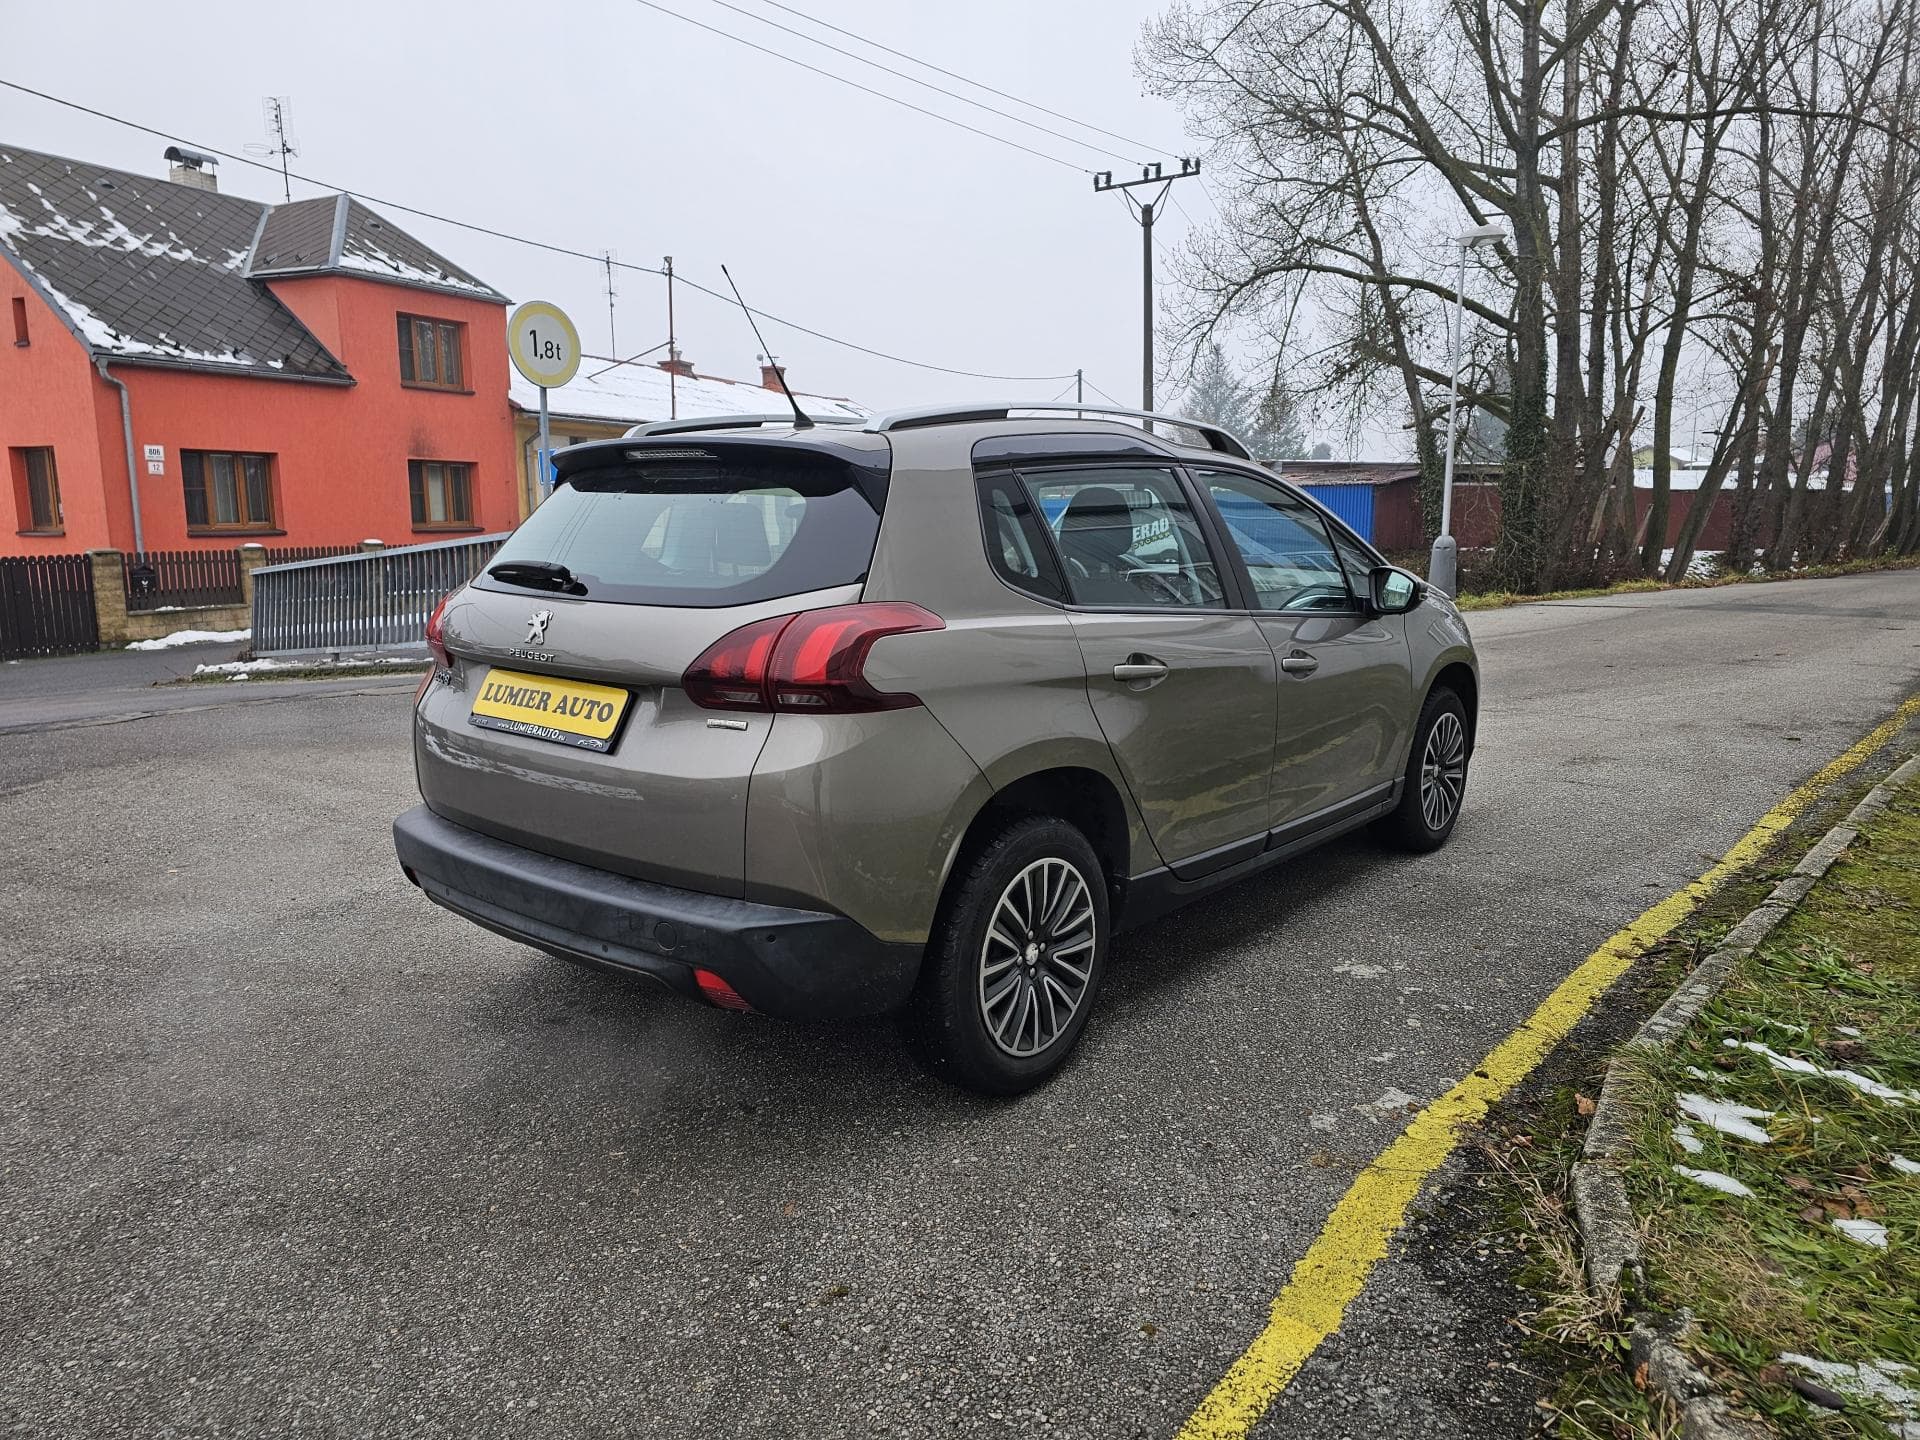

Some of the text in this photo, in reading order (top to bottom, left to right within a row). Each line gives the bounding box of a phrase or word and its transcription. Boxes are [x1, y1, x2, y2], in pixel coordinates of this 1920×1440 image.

[152, 463, 161, 471] 12
[509, 647, 555, 662] PEUGEOT
[482, 682, 614, 723] LUMIER AUTO
